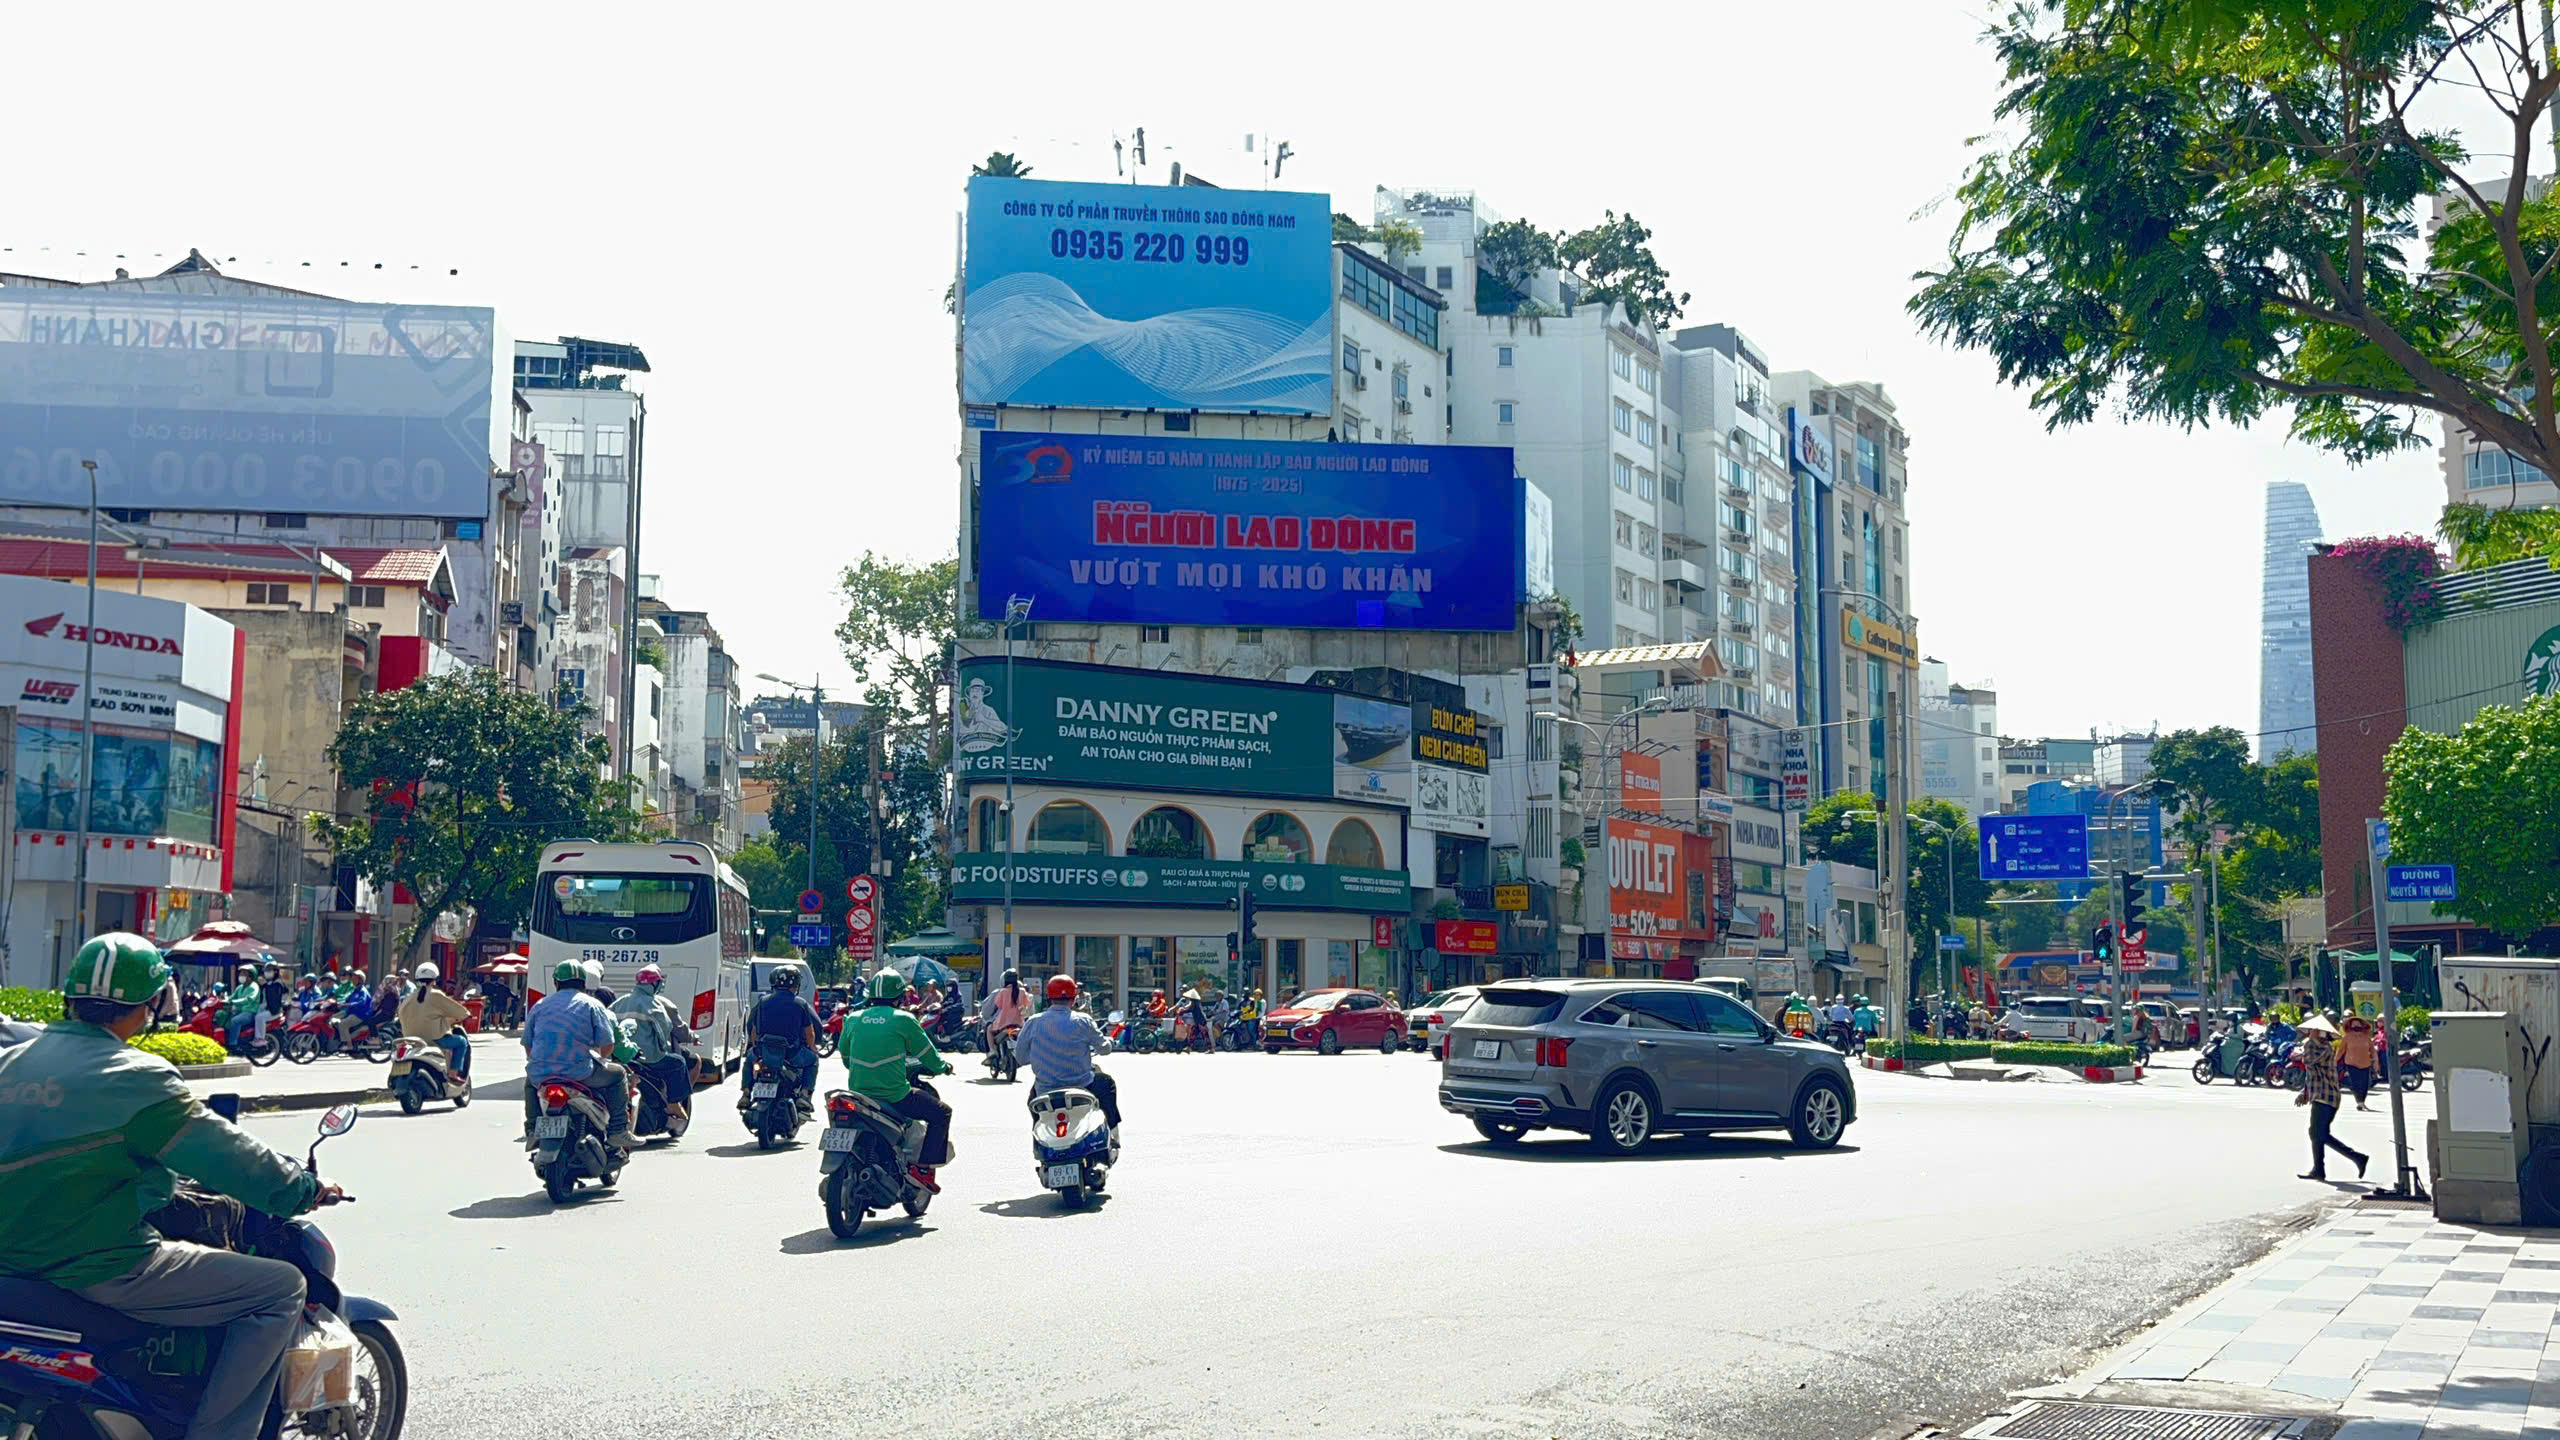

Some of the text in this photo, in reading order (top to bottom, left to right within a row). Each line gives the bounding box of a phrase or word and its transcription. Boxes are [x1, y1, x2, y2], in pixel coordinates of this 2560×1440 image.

[1003, 201, 1036, 216] CÔNG
[1040, 203, 1054, 217] TY
[1113, 204, 1158, 222] TRUYỀN
[1161, 207, 1200, 223] THÔNG
[1205, 210, 1228, 225] SAO
[1268, 215, 1296, 229] NAM
[1051, 229, 1249, 265] 0935 220 999
[1105, 448, 1142, 467] NIỆM
[1147, 450, 1165, 465] 50
[1363, 457, 1387, 473] LAO
[1095, 511, 1215, 546] NGƯỜI
[1226, 514, 1300, 549] LAO
[1070, 558, 1162, 590] VƯỢT
[1178, 563, 1242, 592] MỌI
[1258, 561, 1327, 590] KHÓ
[63, 624, 183, 656] HONDA
[90, 698, 116, 711] EAD
[120, 701, 145, 714] SƠN
[1056, 697, 1163, 726] DANNY
[1059, 724, 1087, 739] ĐẢM
[1090, 725, 1117, 741] BẢO
[1166, 733, 1199, 748] THỰC
[1202, 733, 1235, 750] PHẨM
[1238, 739, 1272, 754] SẠCH,
[1081, 745, 1099, 758] AN
[1101, 744, 1134, 760] TOÀN
[1138, 750, 1165, 763] CHO
[1167, 752, 1188, 764] GIA
[1190, 751, 1218, 767] ĐÌNH
[1221, 755, 1246, 770] BẠN
[1442, 741, 1462, 763] CUA
[1785, 749, 1804, 757] NHA
[1783, 761, 1808, 770] KHOA
[1784, 772, 1808, 785] TÂM
[1736, 820, 1780, 849] NHA KHOA
[971, 866, 1098, 885] FOODSTUFFS
[1608, 836, 1676, 894] OUTLET
[2402, 868, 2440, 880] ĐƯỜNG
[2390, 882, 2417, 896] NGUYỄN
[2420, 886, 2431, 897] THỊ
[1631, 909, 1657, 937] 50%
[861, 1016, 886, 1024] Grab
[0, 1346, 69, 1368] Future
